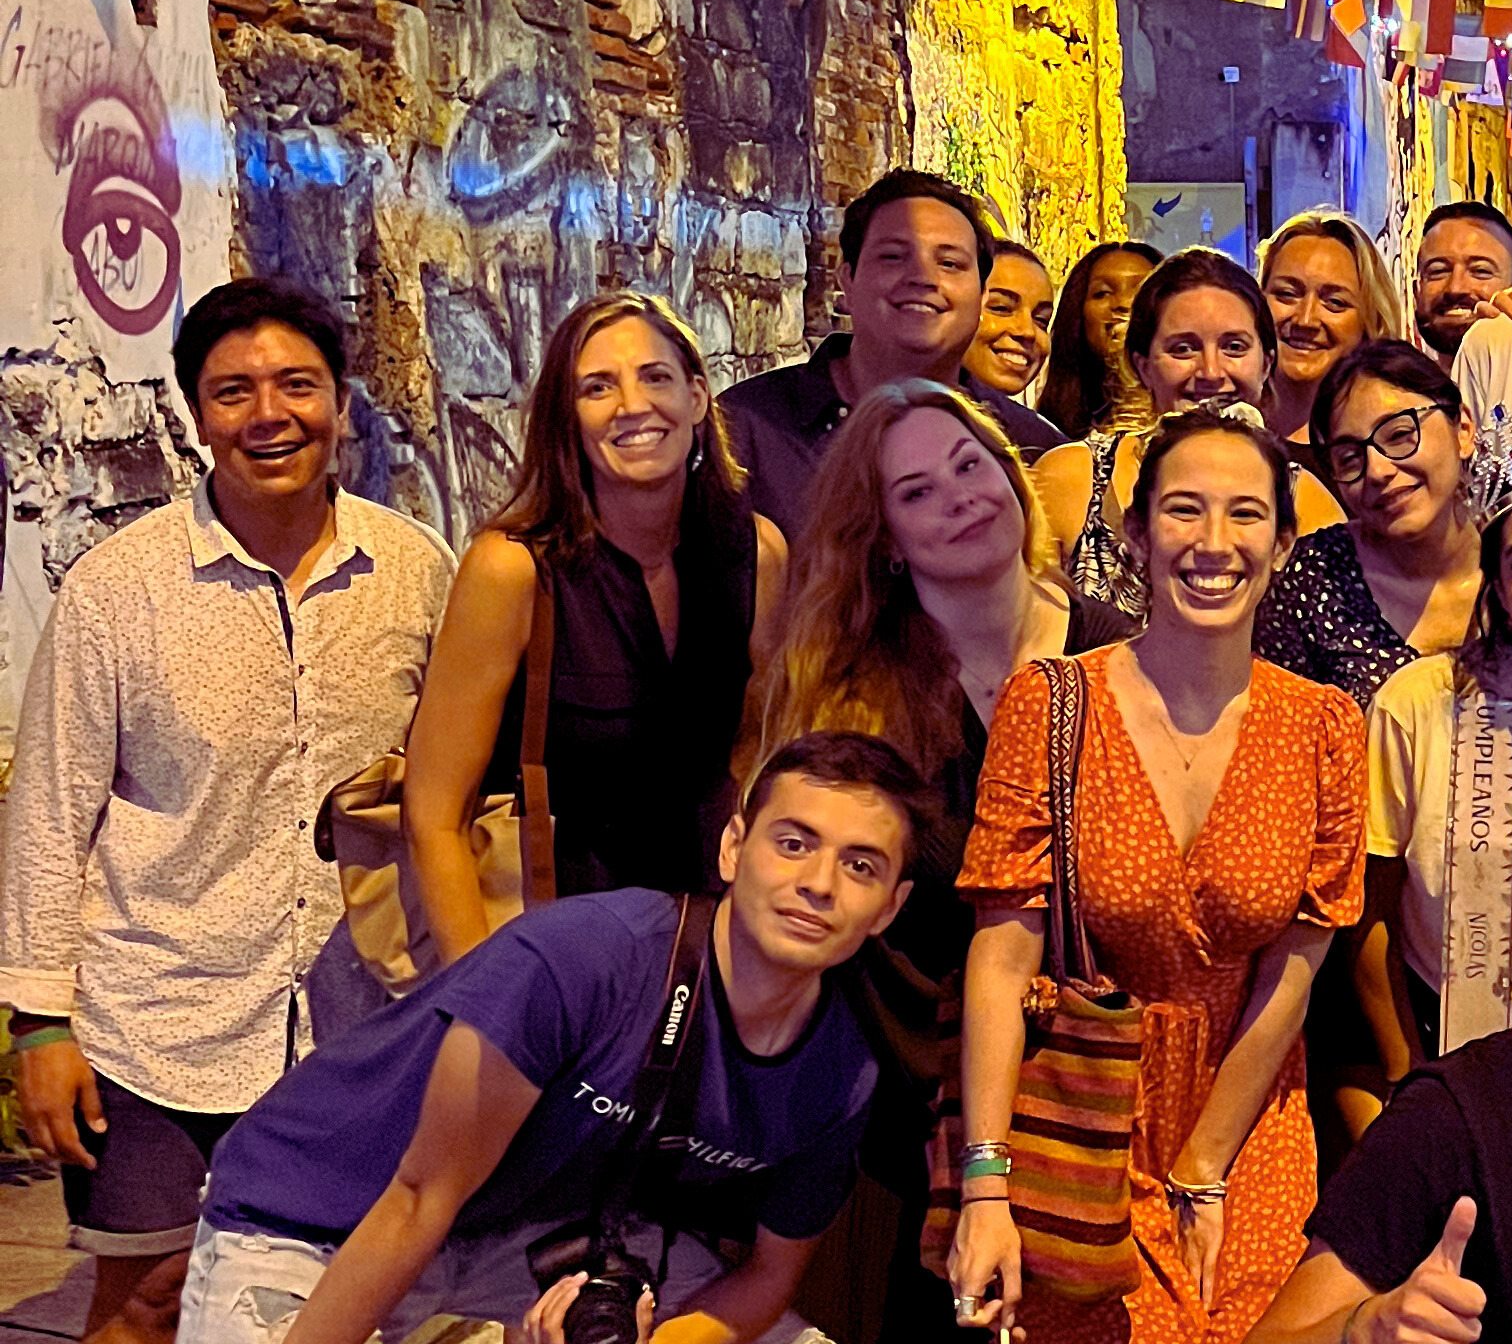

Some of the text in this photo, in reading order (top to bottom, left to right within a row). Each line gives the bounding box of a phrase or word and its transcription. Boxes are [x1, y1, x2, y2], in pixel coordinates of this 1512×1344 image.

[1469, 689, 1497, 853] CUMPLEAÑOS
[1465, 912, 1487, 979] NICOLAS
[661, 984, 690, 1045] Canon
